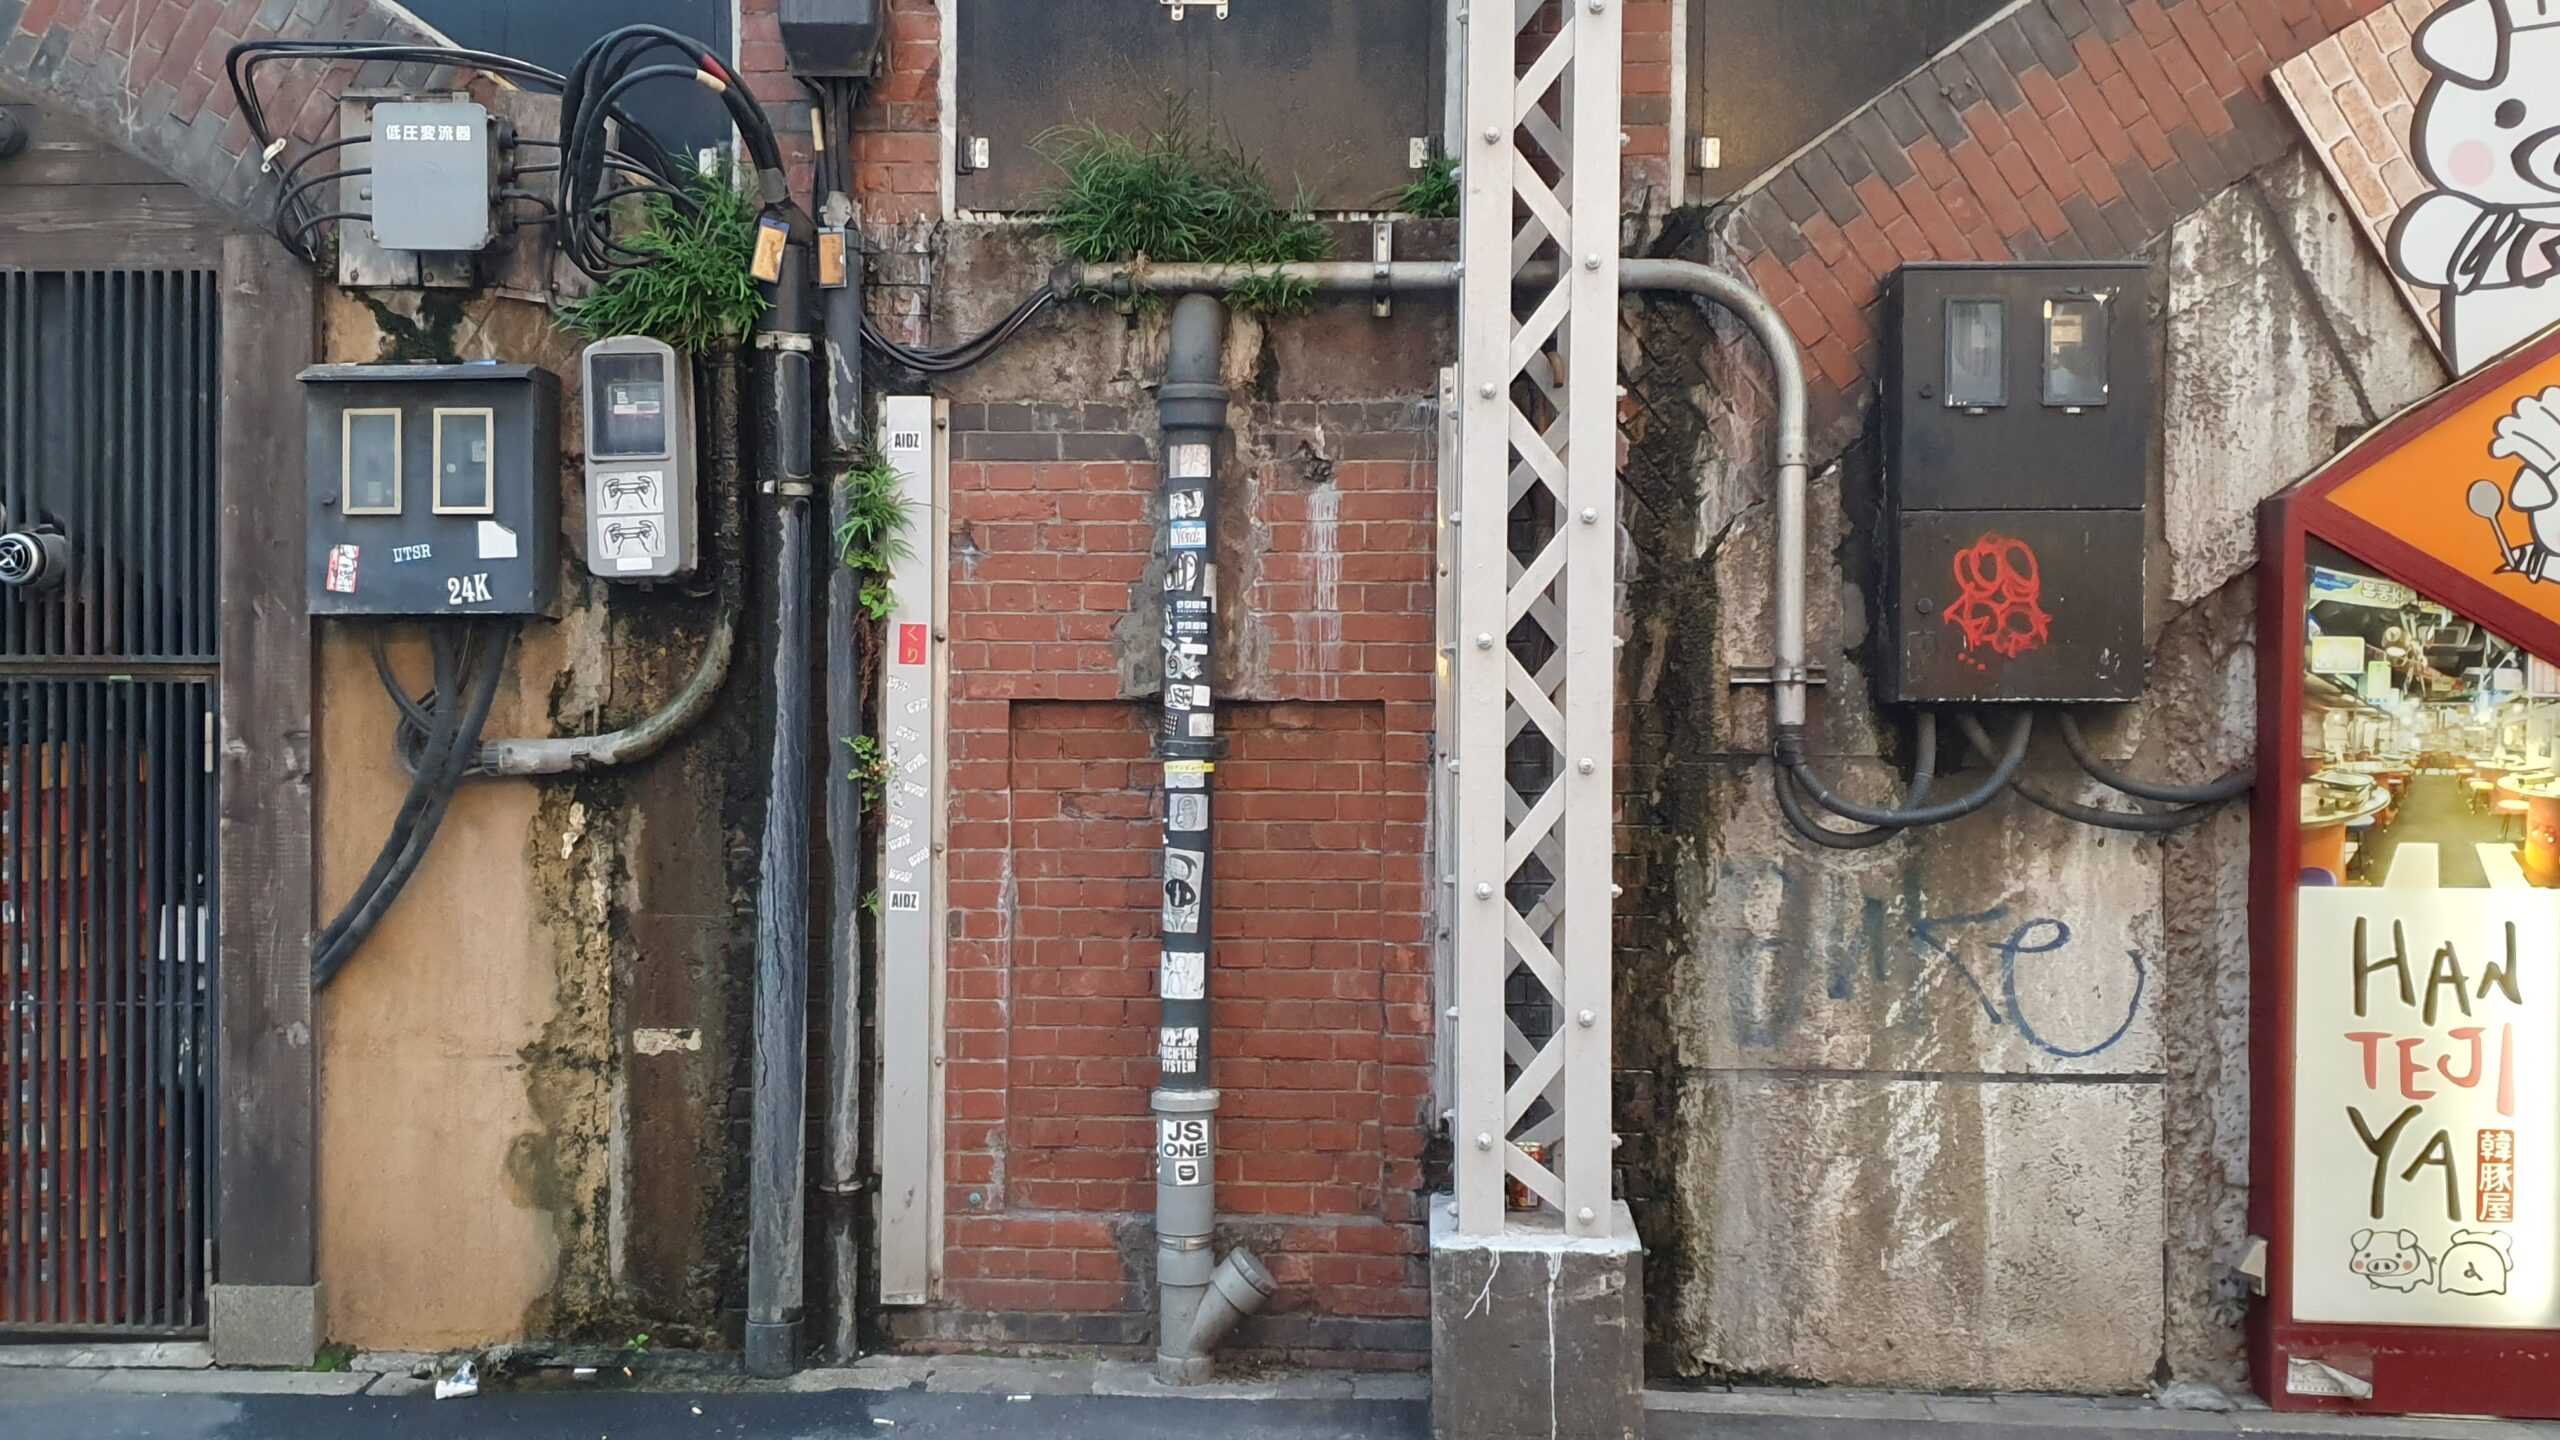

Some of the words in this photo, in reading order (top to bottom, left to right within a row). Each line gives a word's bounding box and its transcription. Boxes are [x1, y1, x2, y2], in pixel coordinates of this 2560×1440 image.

[385, 124, 471, 141] 低圧変流器
[894, 432, 920, 449] AIDZ
[447, 572, 493, 605] 24K
[891, 892, 918, 909] AIDZ
[2353, 916, 2523, 1028] HAN
[2343, 1022, 2515, 1118] TEJI
[1167, 1121, 1203, 1142] JS
[1163, 1142, 1208, 1158] ONE
[2345, 1104, 2463, 1223] YA
[2479, 1130, 2513, 1222] 韓豚屋
